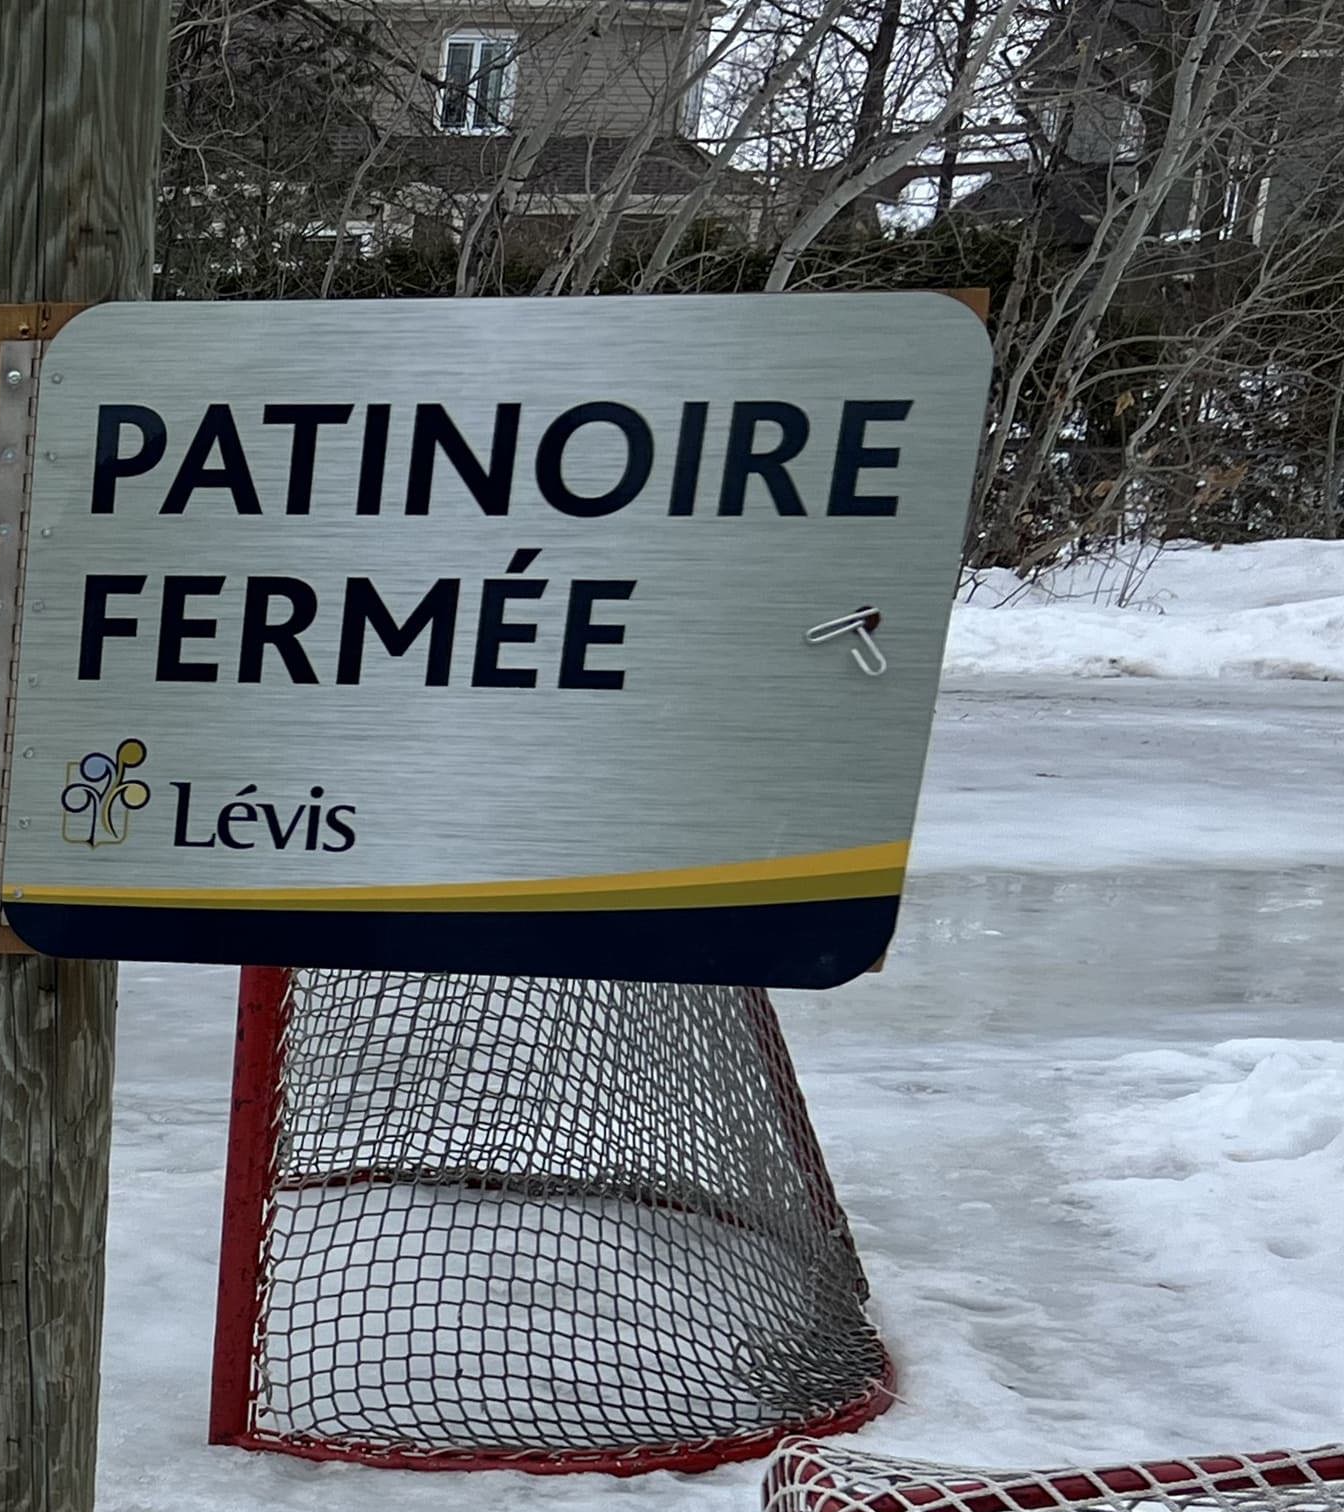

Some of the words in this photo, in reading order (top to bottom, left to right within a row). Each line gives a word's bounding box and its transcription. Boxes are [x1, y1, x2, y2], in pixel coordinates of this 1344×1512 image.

[90, 399, 916, 519] PATINOIRE
[77, 547, 638, 691] FERMÉE
[168, 781, 358, 853] Lévis
